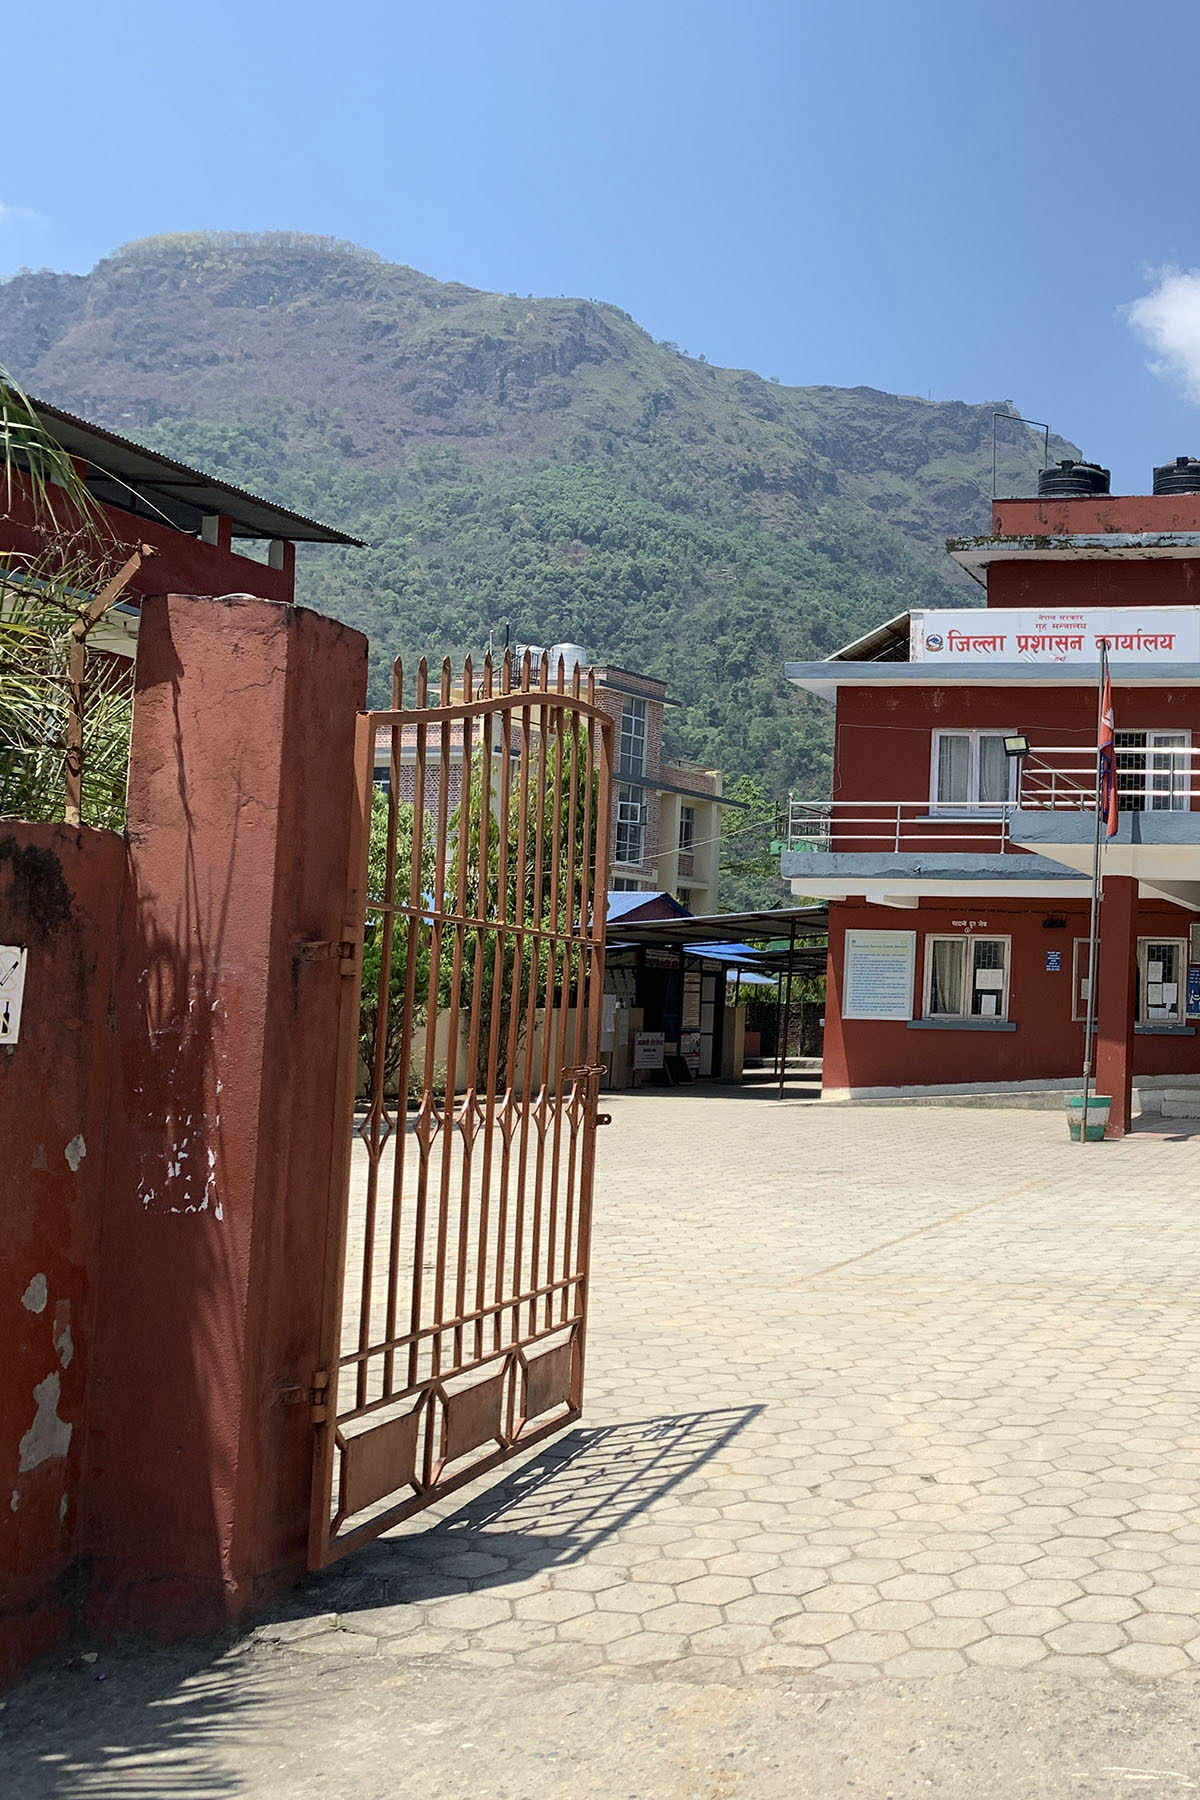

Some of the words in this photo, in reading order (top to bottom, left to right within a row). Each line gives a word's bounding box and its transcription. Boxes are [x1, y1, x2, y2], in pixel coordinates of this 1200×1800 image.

[947, 629, 1007, 654] जिल्ला
[1016, 635, 1085, 654] प्रशासन
[1094, 628, 1176, 652] कार्यालय
